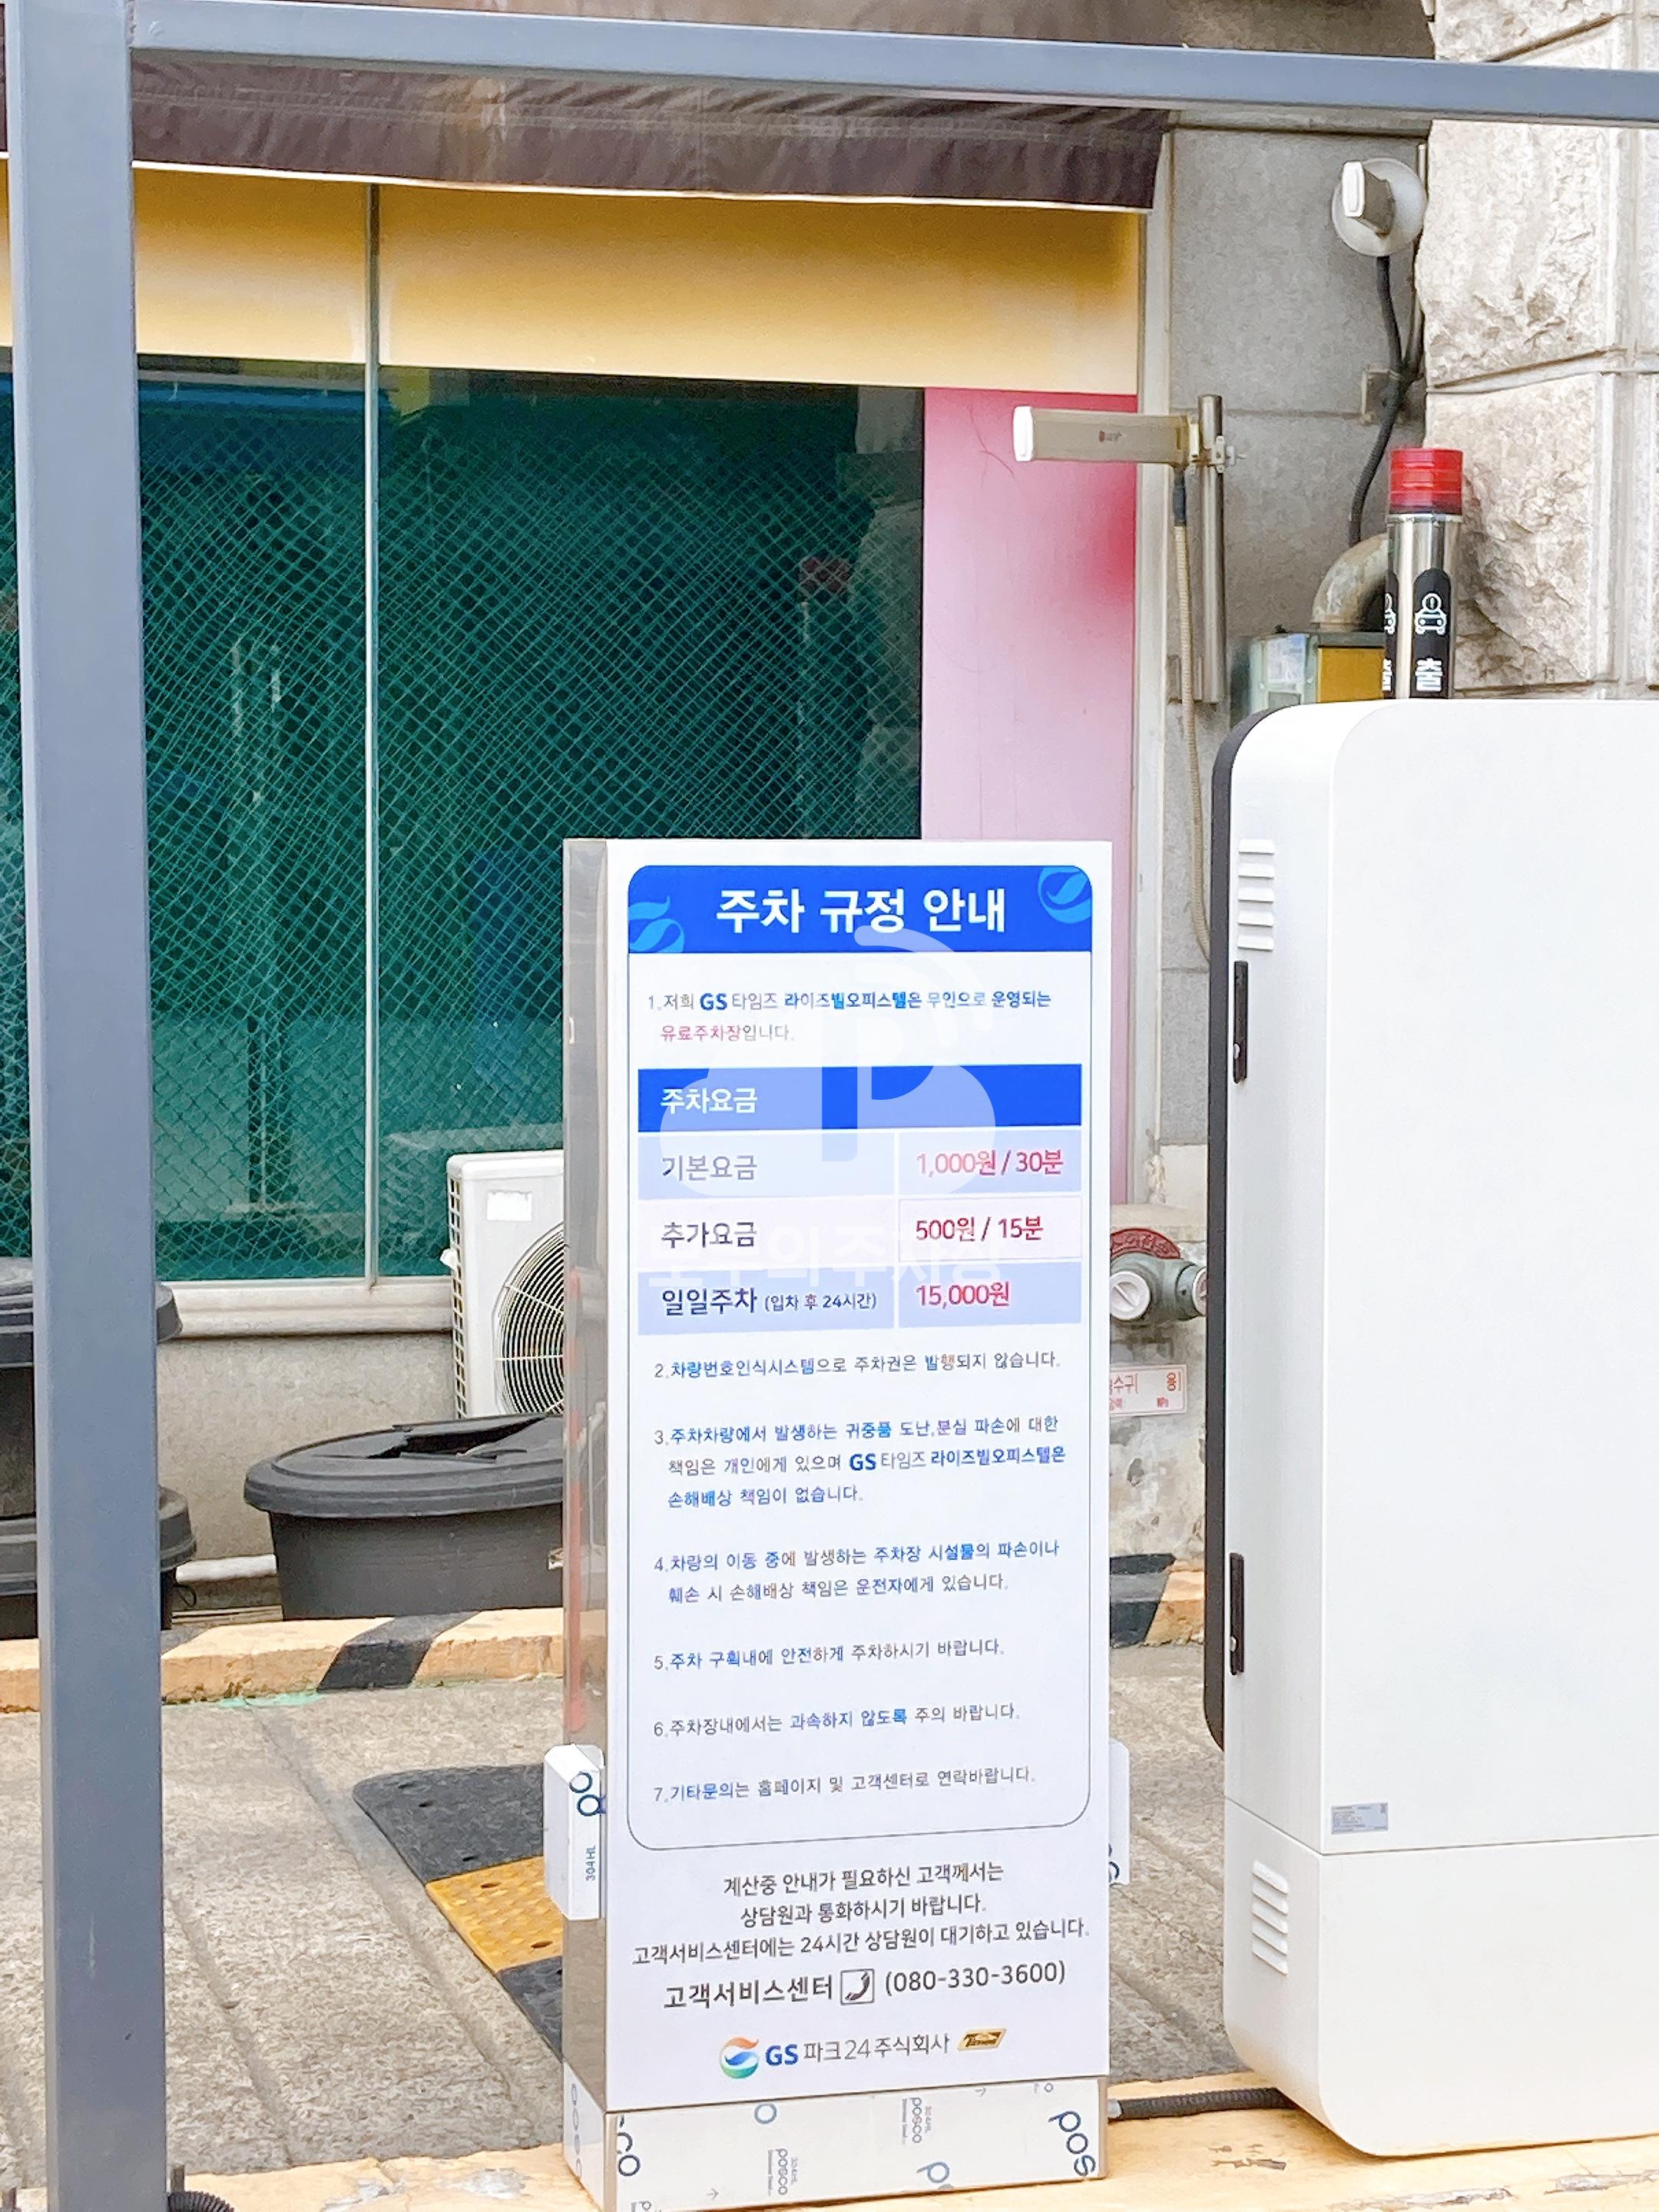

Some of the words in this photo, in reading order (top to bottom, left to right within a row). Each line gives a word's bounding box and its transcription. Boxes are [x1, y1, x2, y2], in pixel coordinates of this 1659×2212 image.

[715, 886, 805, 935] 주차
[818, 886, 906, 935] 규정
[922, 886, 1008, 935] 안내
[700, 992, 727, 1011] GS
[732, 993, 778, 1010] 타임즈
[784, 991, 922, 1010] 라이즈빌오피스텔은
[926, 991, 985, 1008] 무인으로
[992, 990, 1051, 1008] 운영되는
[660, 1087, 758, 1114] 주차요금
[661, 1155, 757, 1181] 기본요금
[661, 1222, 757, 1249] 추가요금
[662, 1287, 757, 1316] 일일주차
[765, 1295, 799, 1312] (입차
[803, 1293, 818, 1311] 후
[823, 1292, 876, 1310] 24시간)
[916, 1282, 1010, 1306] 15,000원
[854, 1355, 918, 1373] 주차권은
[925, 1353, 986, 1371] 발행되지
[994, 1351, 1061, 1369] 않습니다.
[775, 1423, 838, 1442] 발생하는
[846, 1421, 892, 1439] 귀중품
[974, 1417, 1019, 1435] 파손에
[1028, 1416, 1058, 1432] 대한
[668, 1459, 716, 1476] 책임은
[724, 1456, 786, 1475] 개인에게
[796, 1454, 841, 1472] 있으며
[849, 1452, 877, 1471] GS
[880, 1452, 926, 1469] 타임즈
[667, 1489, 733, 1508] 손해배상
[740, 1487, 786, 1505] 책임이
[795, 1485, 863, 1504] 없습니다.
[727, 1553, 757, 1570] 이동
[765, 1551, 796, 1568] 중에
[803, 1548, 866, 1567] 발생하는
[873, 1545, 922, 1564] 주차장
[929, 1542, 989, 1561] 시설물의
[997, 1539, 1059, 1558] 파손이나
[707, 1584, 722, 1601] 시
[730, 1582, 794, 1601] 손해배상
[802, 1580, 848, 1598] 책임은
[856, 1576, 933, 1595] 운전자에게
[942, 1573, 1010, 1591] 있습니다.
[709, 1648, 773, 1668] 구획내에
[781, 1645, 843, 1664] 안전하게
[851, 1641, 929, 1661] 주차하시기
[938, 1638, 1006, 1657] 바랍니다.
[790, 1710, 853, 1730] 과속하지
[861, 1708, 907, 1727] 않도록
[915, 1707, 945, 1724] 주의
[953, 1703, 1021, 1722] 바랍니다.
[757, 1777, 820, 1797] 홈페이지
[830, 1776, 843, 1793] 및
[850, 1772, 929, 1790] 고객센터로
[938, 1766, 1037, 1786] 연락바랍니다.
[724, 1875, 777, 1897] 계산중
[783, 1871, 836, 1894] 안내가
[841, 1866, 911, 1891] 필요하신
[916, 1862, 1004, 1884] 고객께서는
[740, 1903, 813, 1928] 상담원과
[817, 1897, 905, 1924] 통화하시기
[912, 1892, 988, 1917] 바랍니다.
[632, 1937, 795, 1965] 고객서비스센터에는
[800, 1932, 860, 1954] 24시간
[865, 1927, 934, 1952] 상담원이
[941, 1923, 1010, 1945] 대기하고
[1015, 1917, 1090, 1942] 있습니다.
[664, 1974, 833, 2009] 고객서비스센터
[886, 1960, 1065, 1996] (080-330-3600)
[765, 2044, 799, 2067] GS
